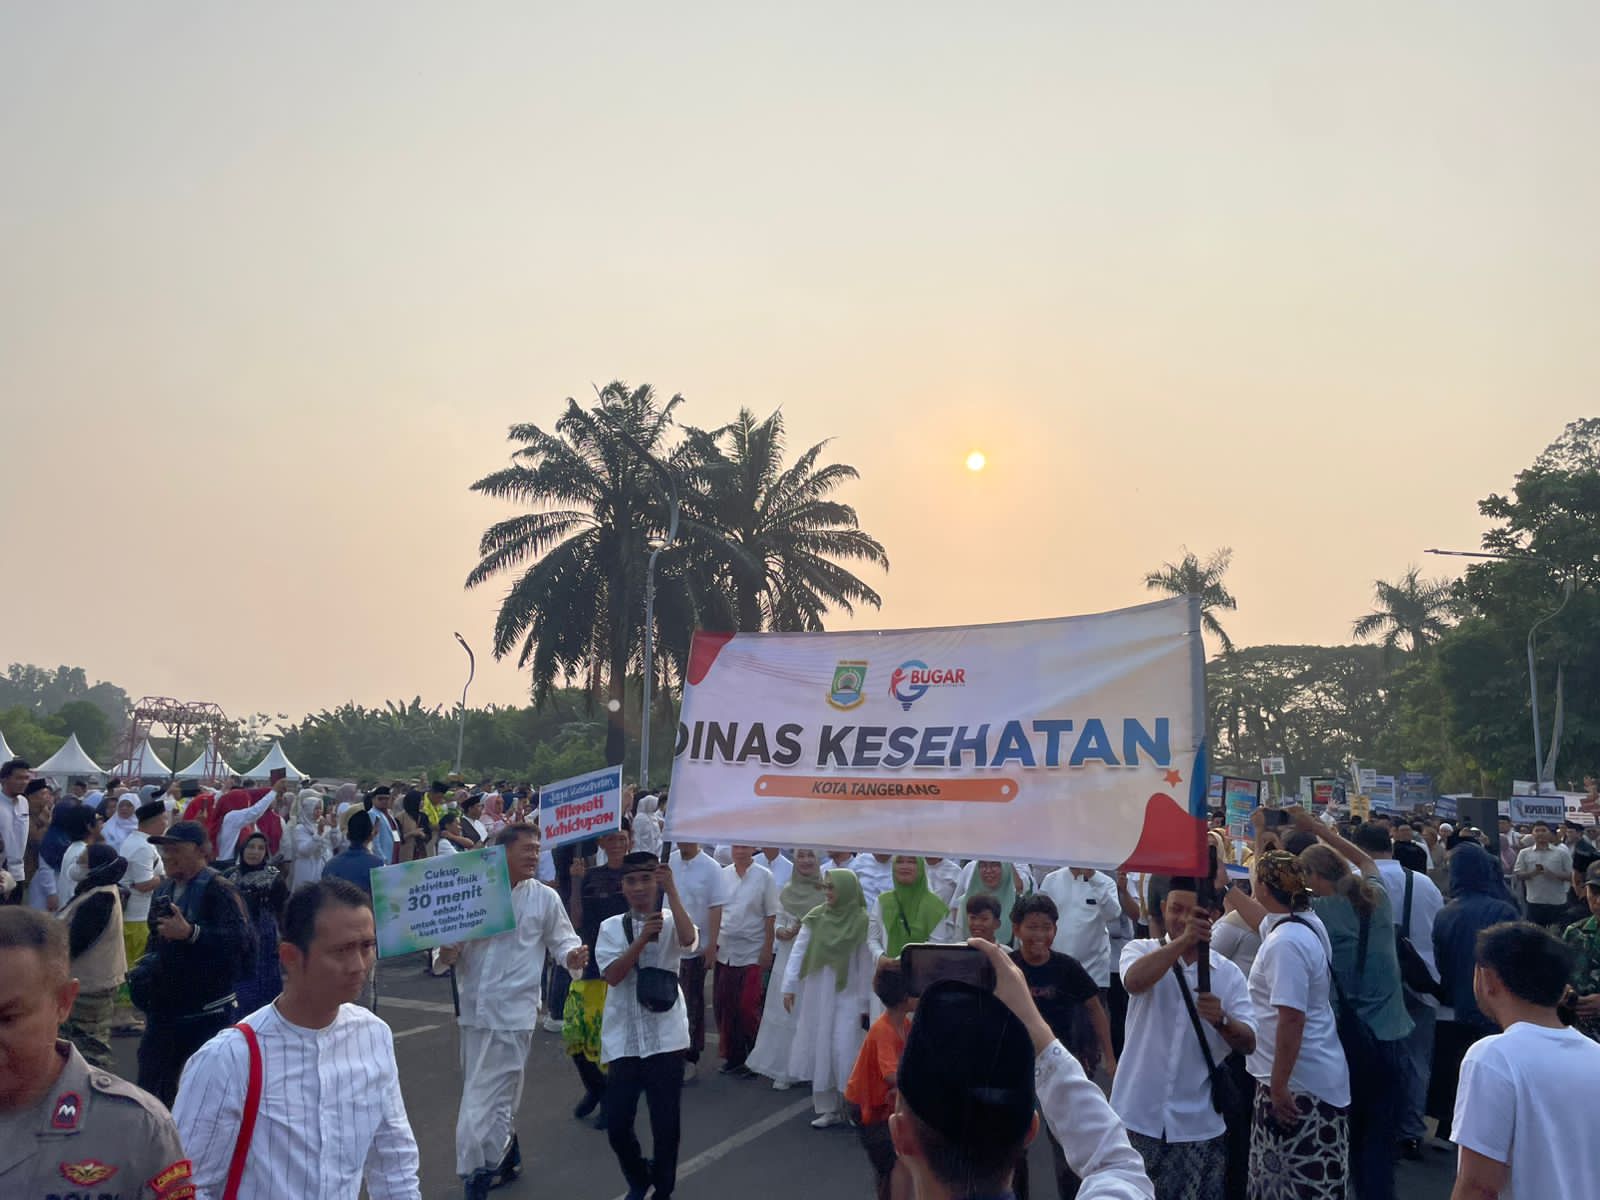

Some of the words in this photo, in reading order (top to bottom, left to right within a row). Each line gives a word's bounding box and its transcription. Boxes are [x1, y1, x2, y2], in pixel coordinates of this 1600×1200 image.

[911, 668, 966, 684] BUGAR
[816, 717, 1171, 767] KESEHATAN
[812, 781, 848, 795] KOTA
[850, 782, 940, 796] TANGERANG
[555, 795, 604, 821] Nikmati
[409, 879, 454, 896] aktivitas
[457, 873, 478, 885] fisik
[424, 867, 460, 881] Cukup
[408, 893, 431, 912] 30
[436, 885, 482, 906] menit
[410, 919, 436, 931] untuk
[466, 908, 488, 920] lebih
[442, 922, 457, 933] dan
